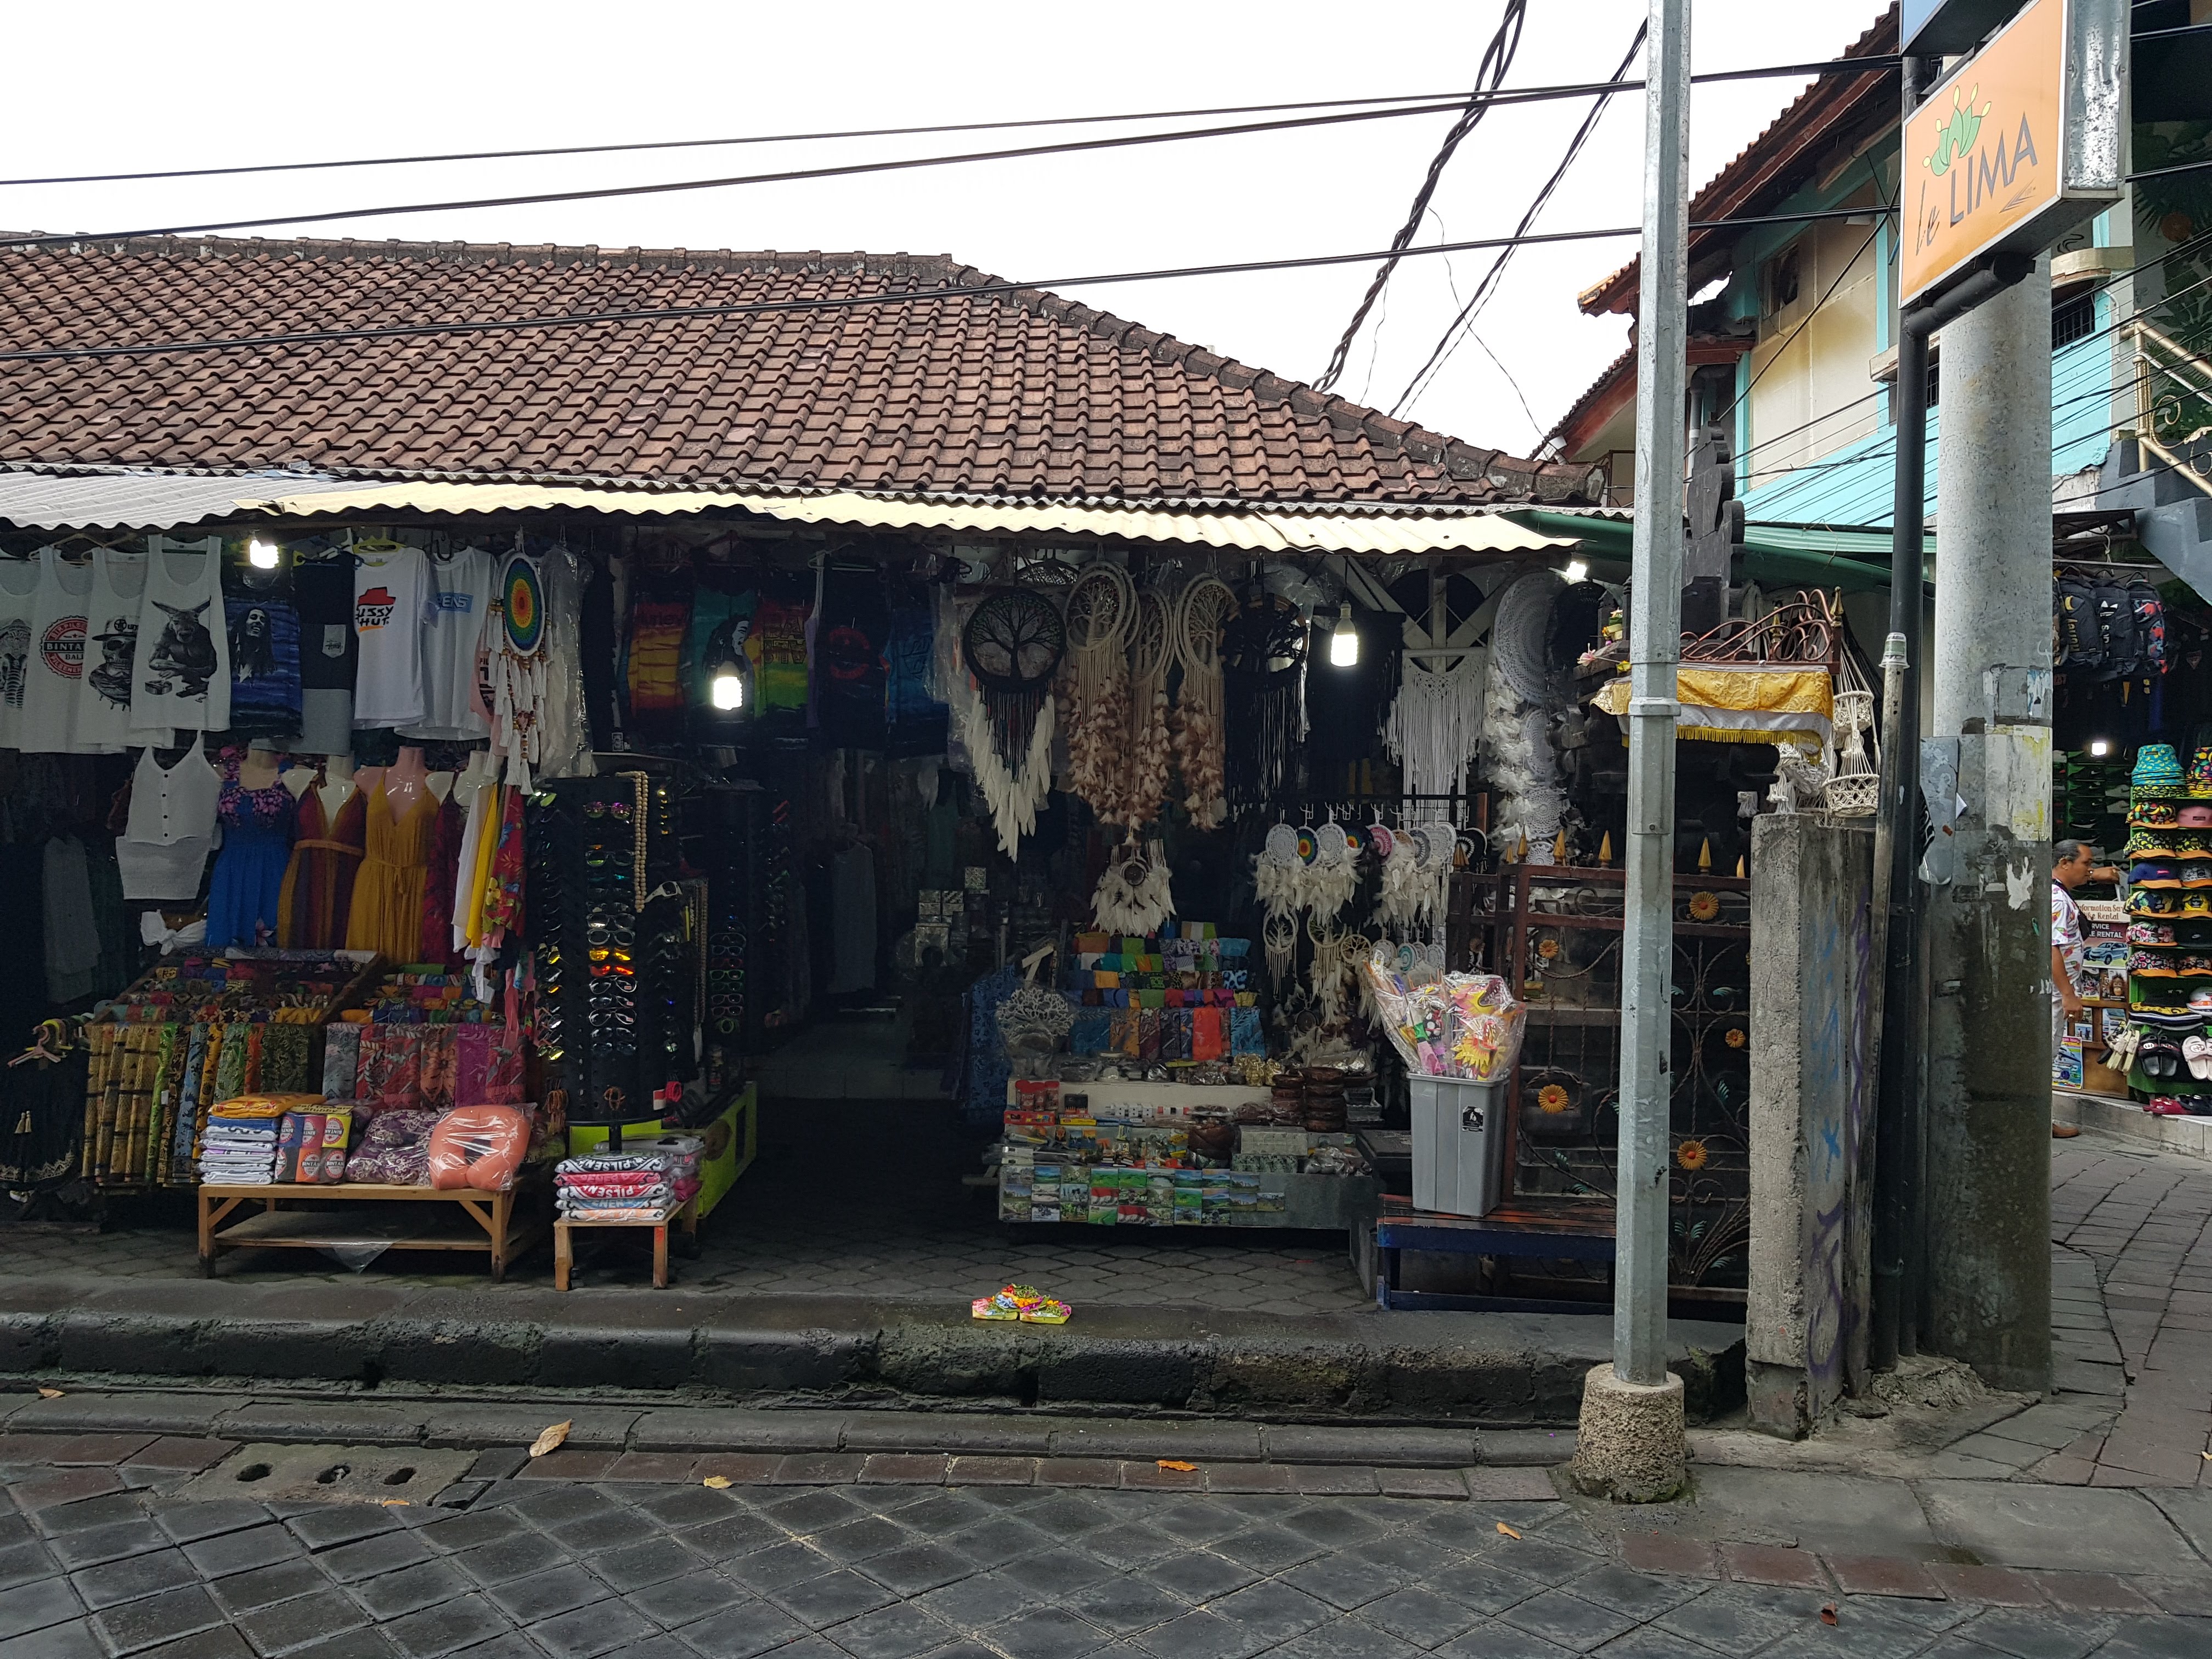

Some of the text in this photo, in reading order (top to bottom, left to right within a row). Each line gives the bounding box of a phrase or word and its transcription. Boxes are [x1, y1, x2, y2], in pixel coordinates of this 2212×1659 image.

[1950, 111, 2038, 229] LIMA
[439, 595, 469, 608] ENS
[2080, 904, 2112, 912] nformation
[2097, 912, 2119, 920] Rental
